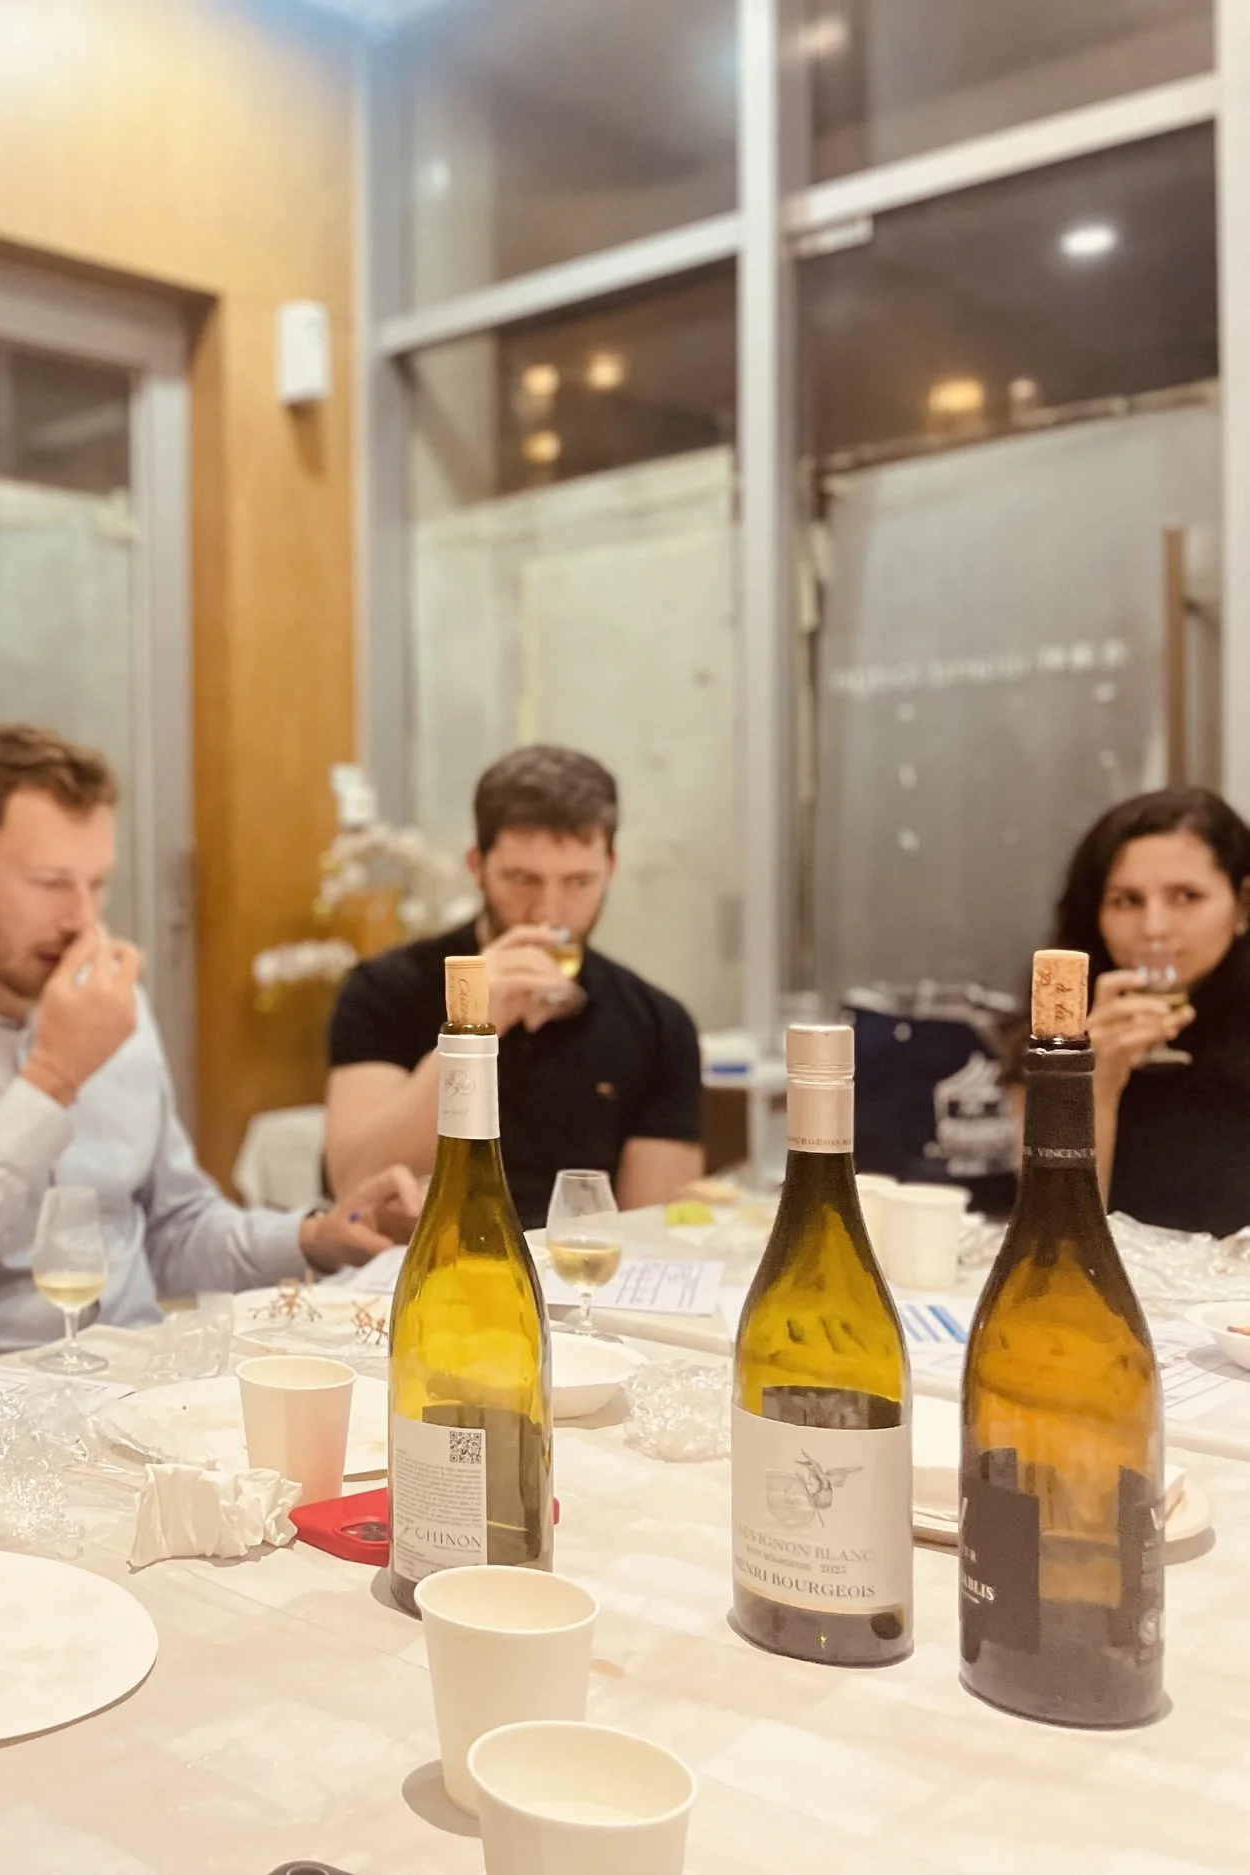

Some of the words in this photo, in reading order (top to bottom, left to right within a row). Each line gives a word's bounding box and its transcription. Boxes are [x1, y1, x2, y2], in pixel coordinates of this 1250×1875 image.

[415, 1526, 482, 1549] CHINON
[763, 1552, 812, 1572] BOURGEOIS
[815, 1545, 875, 1562] BLANC
[734, 1551, 767, 1583] HENRI
[771, 1571, 876, 1599] BOURGEOIS
